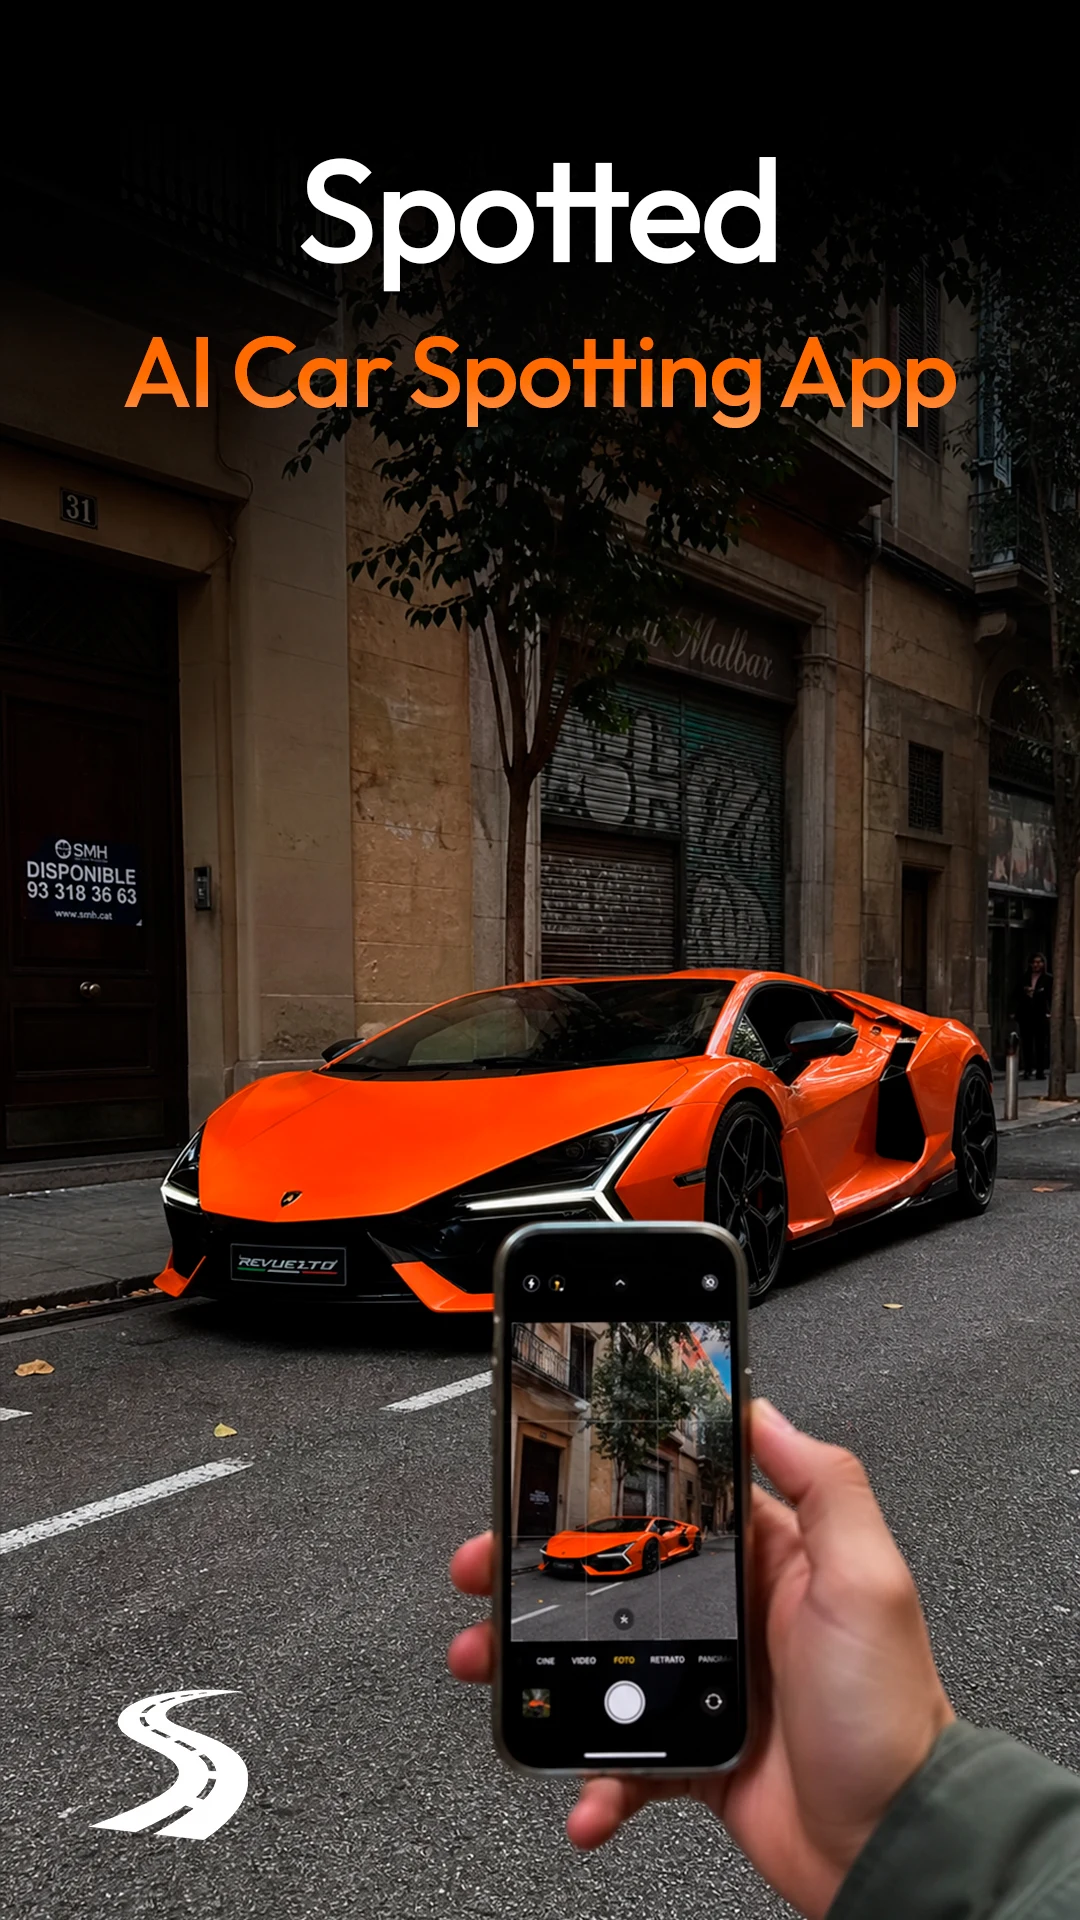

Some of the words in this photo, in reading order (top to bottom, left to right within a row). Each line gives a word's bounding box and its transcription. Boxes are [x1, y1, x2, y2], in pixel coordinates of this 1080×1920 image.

[66, 494, 91, 523] 31
[73, 843, 108, 860] SMH
[26, 860, 137, 886] DISPONIBLE
[26, 880, 49, 899] 93
[54, 882, 87, 902] 318
[91, 885, 112, 903] 36
[116, 887, 138, 905] 63
[54, 909, 113, 921] www.smh.cat
[535, 1657, 556, 1666] CINE
[571, 1656, 597, 1665] VIDEO
[613, 1656, 636, 1665] FOTO
[650, 1655, 686, 1664] RETRATO
